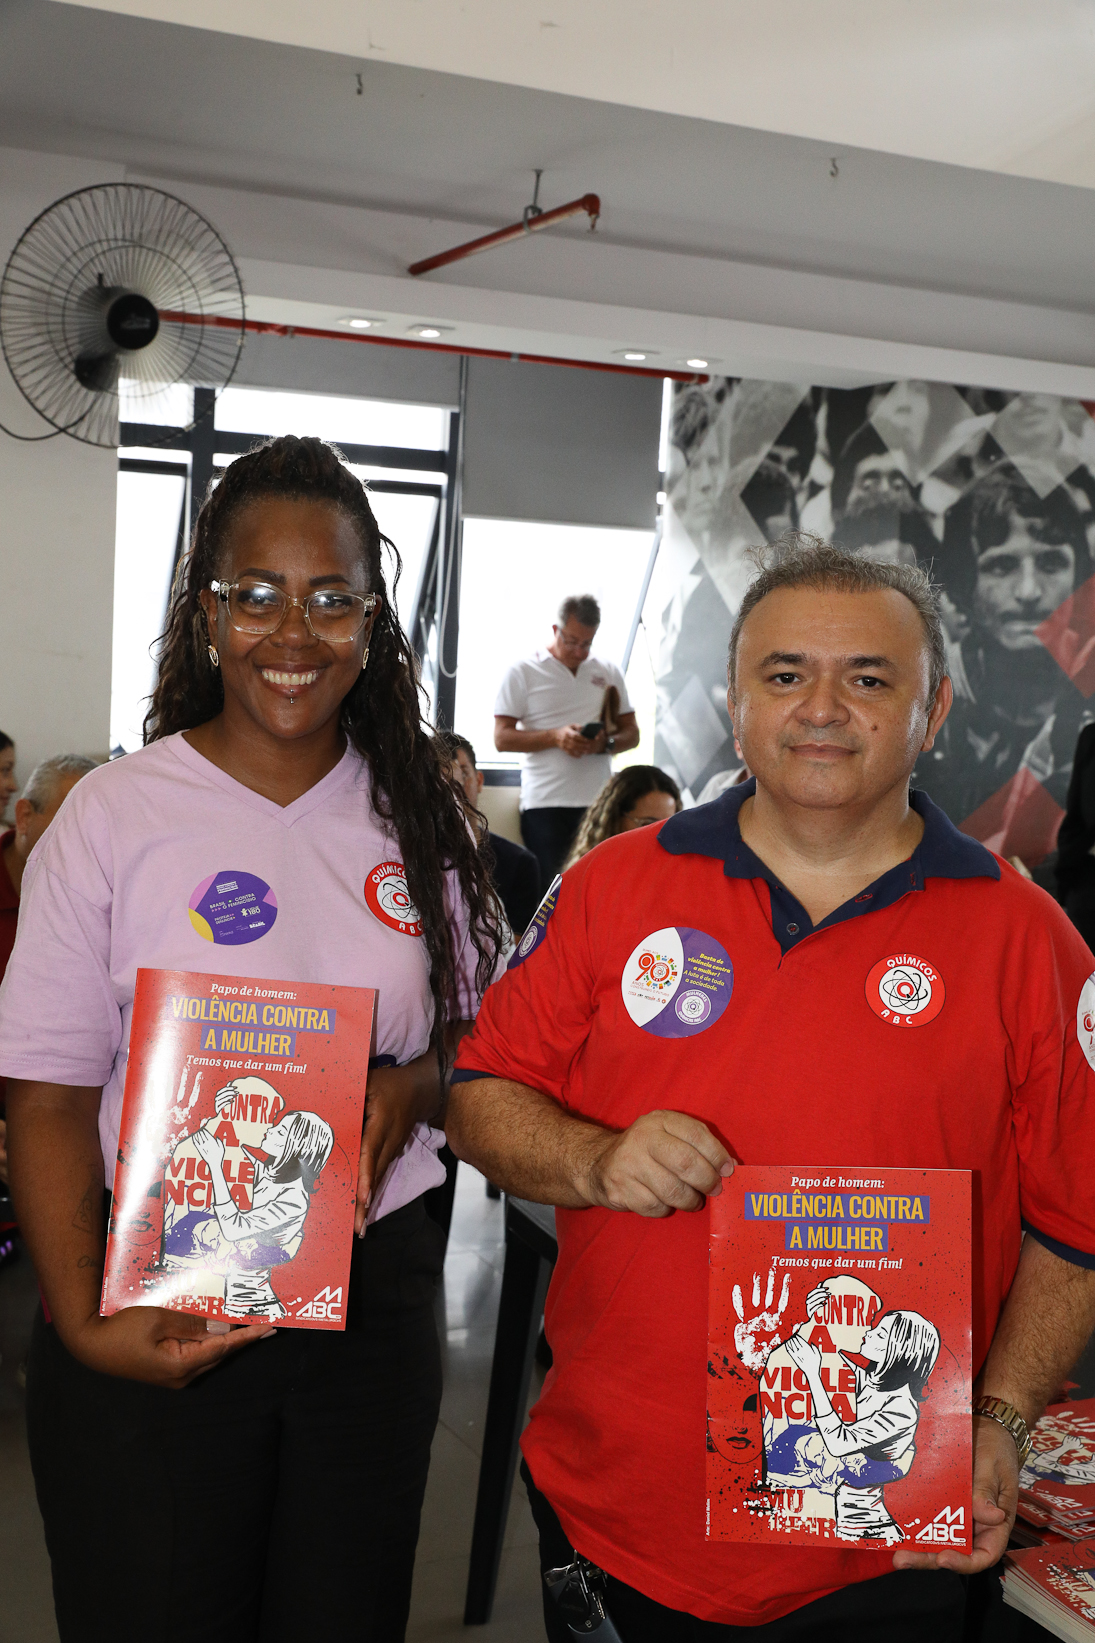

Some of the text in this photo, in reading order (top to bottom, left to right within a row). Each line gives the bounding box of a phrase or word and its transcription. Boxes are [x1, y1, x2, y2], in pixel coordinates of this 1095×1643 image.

[234, 893, 255, 902] CONTRA
[638, 953, 670, 982] 90
[688, 957, 730, 974] violência contra
[700, 953, 716, 962] Basta
[886, 954, 938, 982] QUÍMICOS
[210, 983, 298, 1000] Papo de homem:
[171, 994, 330, 1031] VIOLÊNCIA CONTRA
[204, 1028, 292, 1056] A MULHER
[186, 1054, 307, 1074] Temos que dar um fim!
[213, 1120, 240, 1148] A
[790, 1176, 885, 1190] Papo de homem:
[750, 1188, 924, 1220] VIOLÊNCIA CONTRA
[790, 1226, 884, 1250] A MULHER
[772, 1256, 903, 1271] Temos que dar um fim!
[296, 1301, 342, 1319] ABC
[808, 1325, 836, 1354] A
[915, 1522, 966, 1542] ABC
